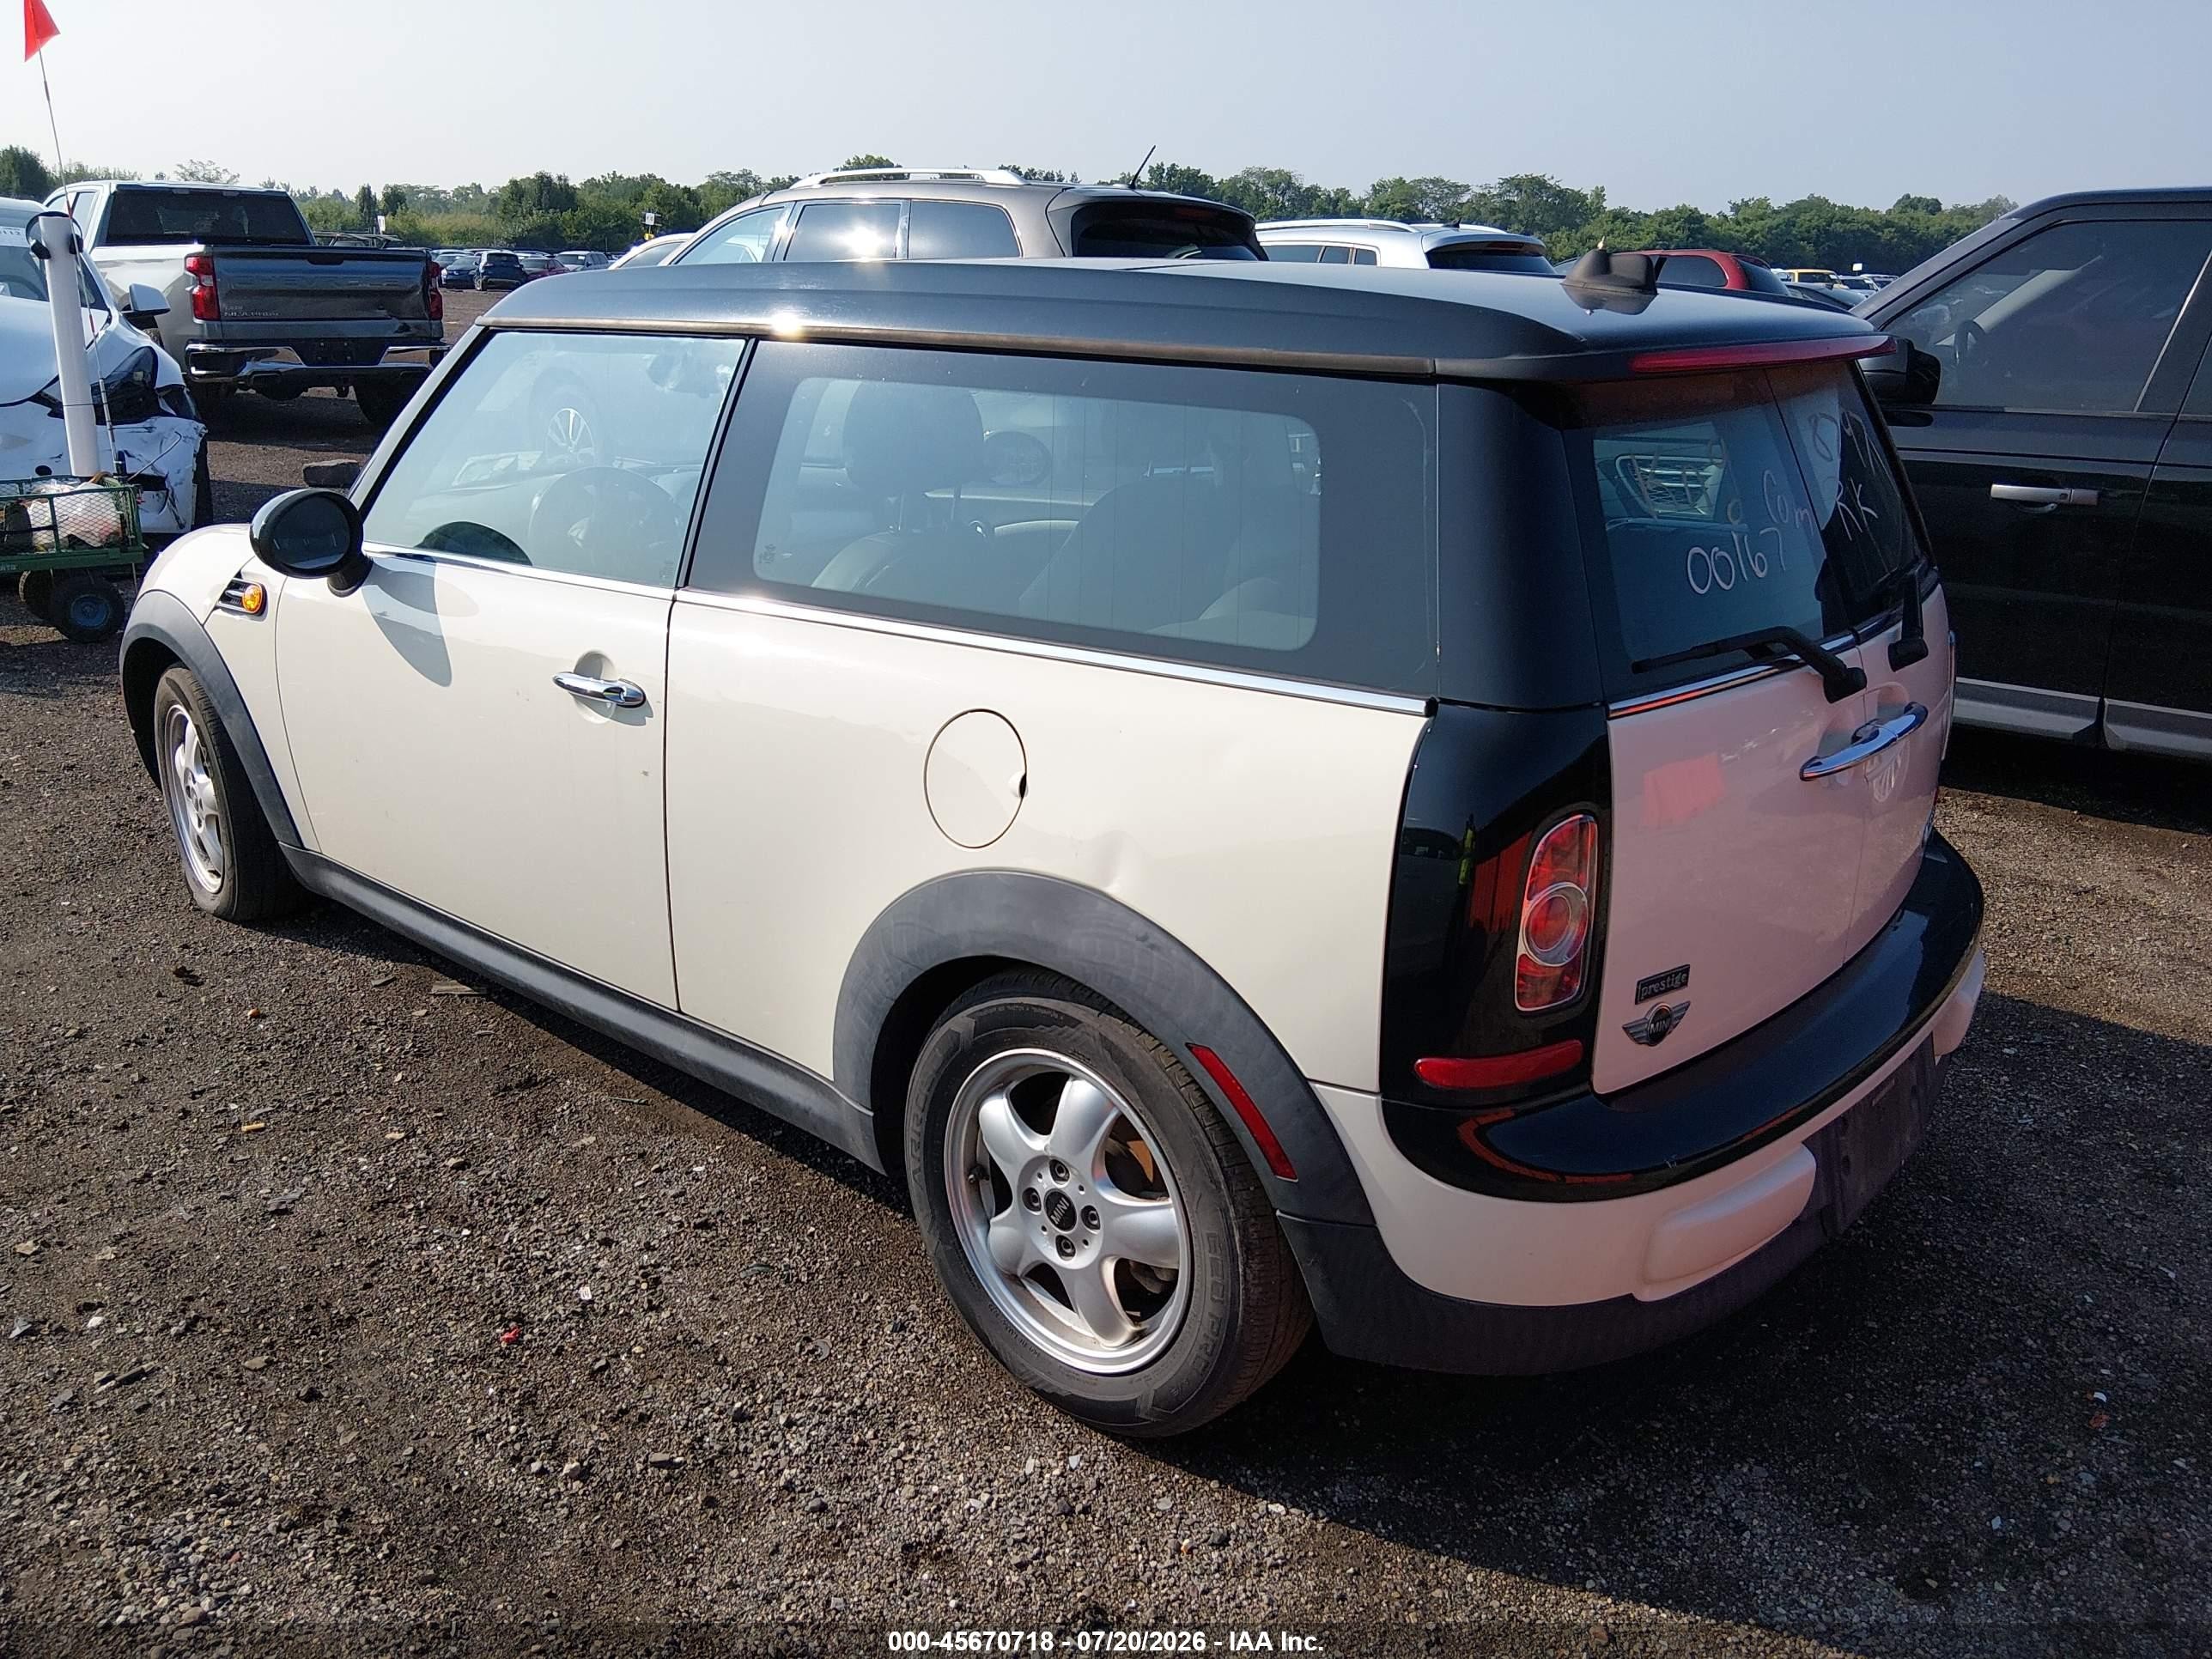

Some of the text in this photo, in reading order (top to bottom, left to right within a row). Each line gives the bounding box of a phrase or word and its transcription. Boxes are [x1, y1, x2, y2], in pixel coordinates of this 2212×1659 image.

[1686, 526, 1786, 594] 00167
[1640, 971, 1687, 1000] prestige
[1650, 1018, 1671, 1034] MINI
[1049, 1195, 1071, 1225] MINI
